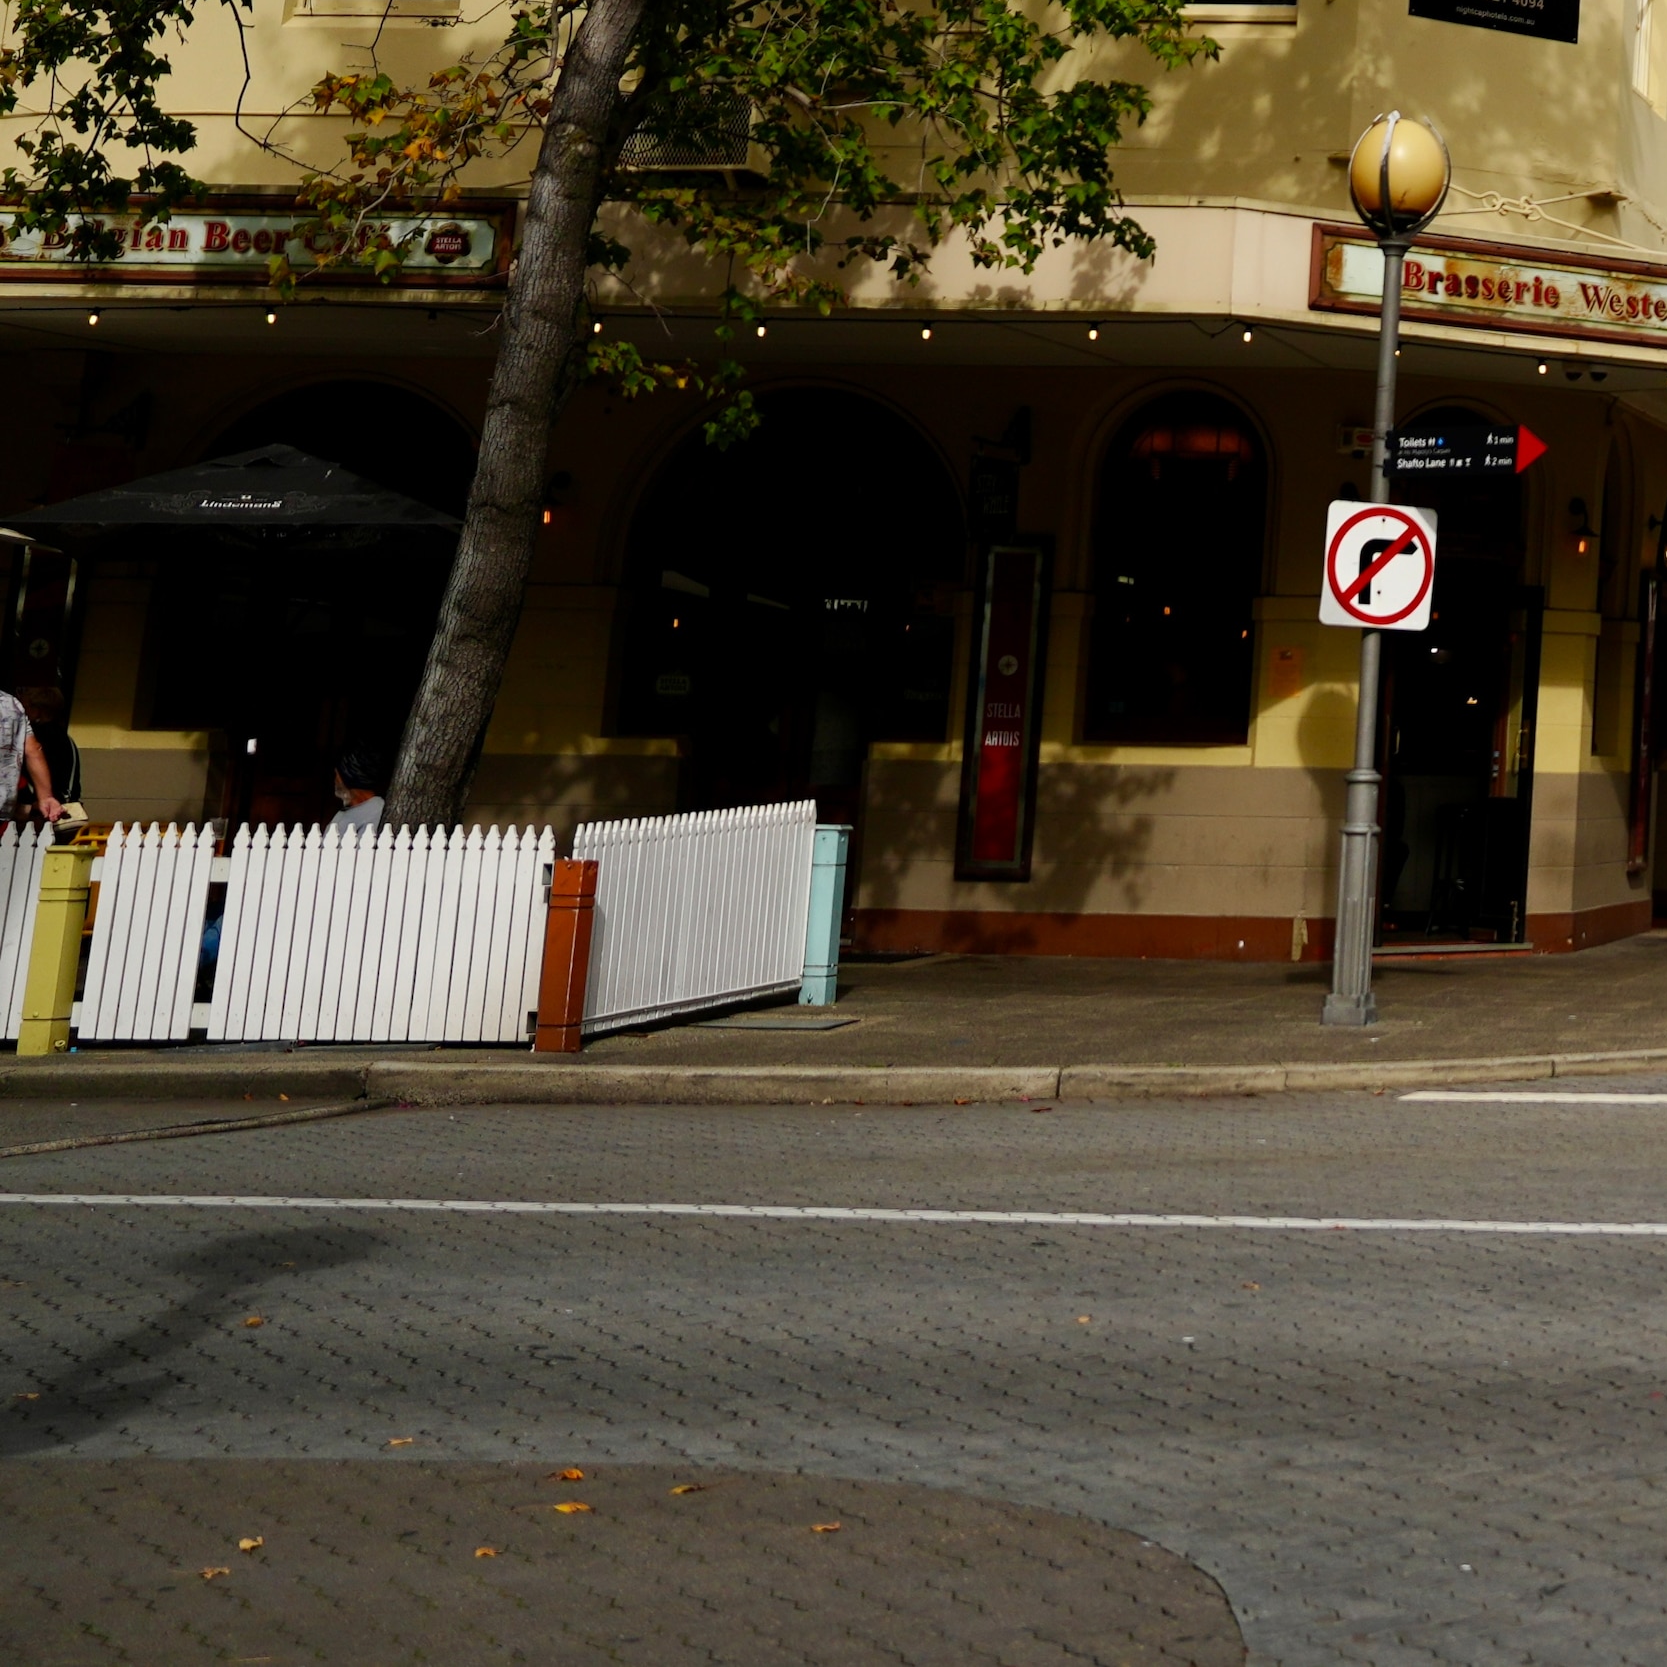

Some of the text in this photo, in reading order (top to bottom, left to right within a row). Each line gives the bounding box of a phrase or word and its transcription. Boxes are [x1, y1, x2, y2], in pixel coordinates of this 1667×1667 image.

[1456, 5, 1536, 26] nightcaphotels.com.au
[202, 220, 290, 253] Beer
[435, 236, 462, 244] STELLA
[435, 243, 462, 251] ARTOIS
[1403, 260, 1560, 308] Brasserie
[1398, 437, 1427, 448] Toilets
[1499, 435, 1514, 445] min
[1397, 457, 1424, 469] Shafto
[1425, 457, 1446, 468] Lane
[1498, 455, 1513, 466] min
[986, 702, 1021, 719] STELLA
[984, 731, 1020, 747] ARTOIS
